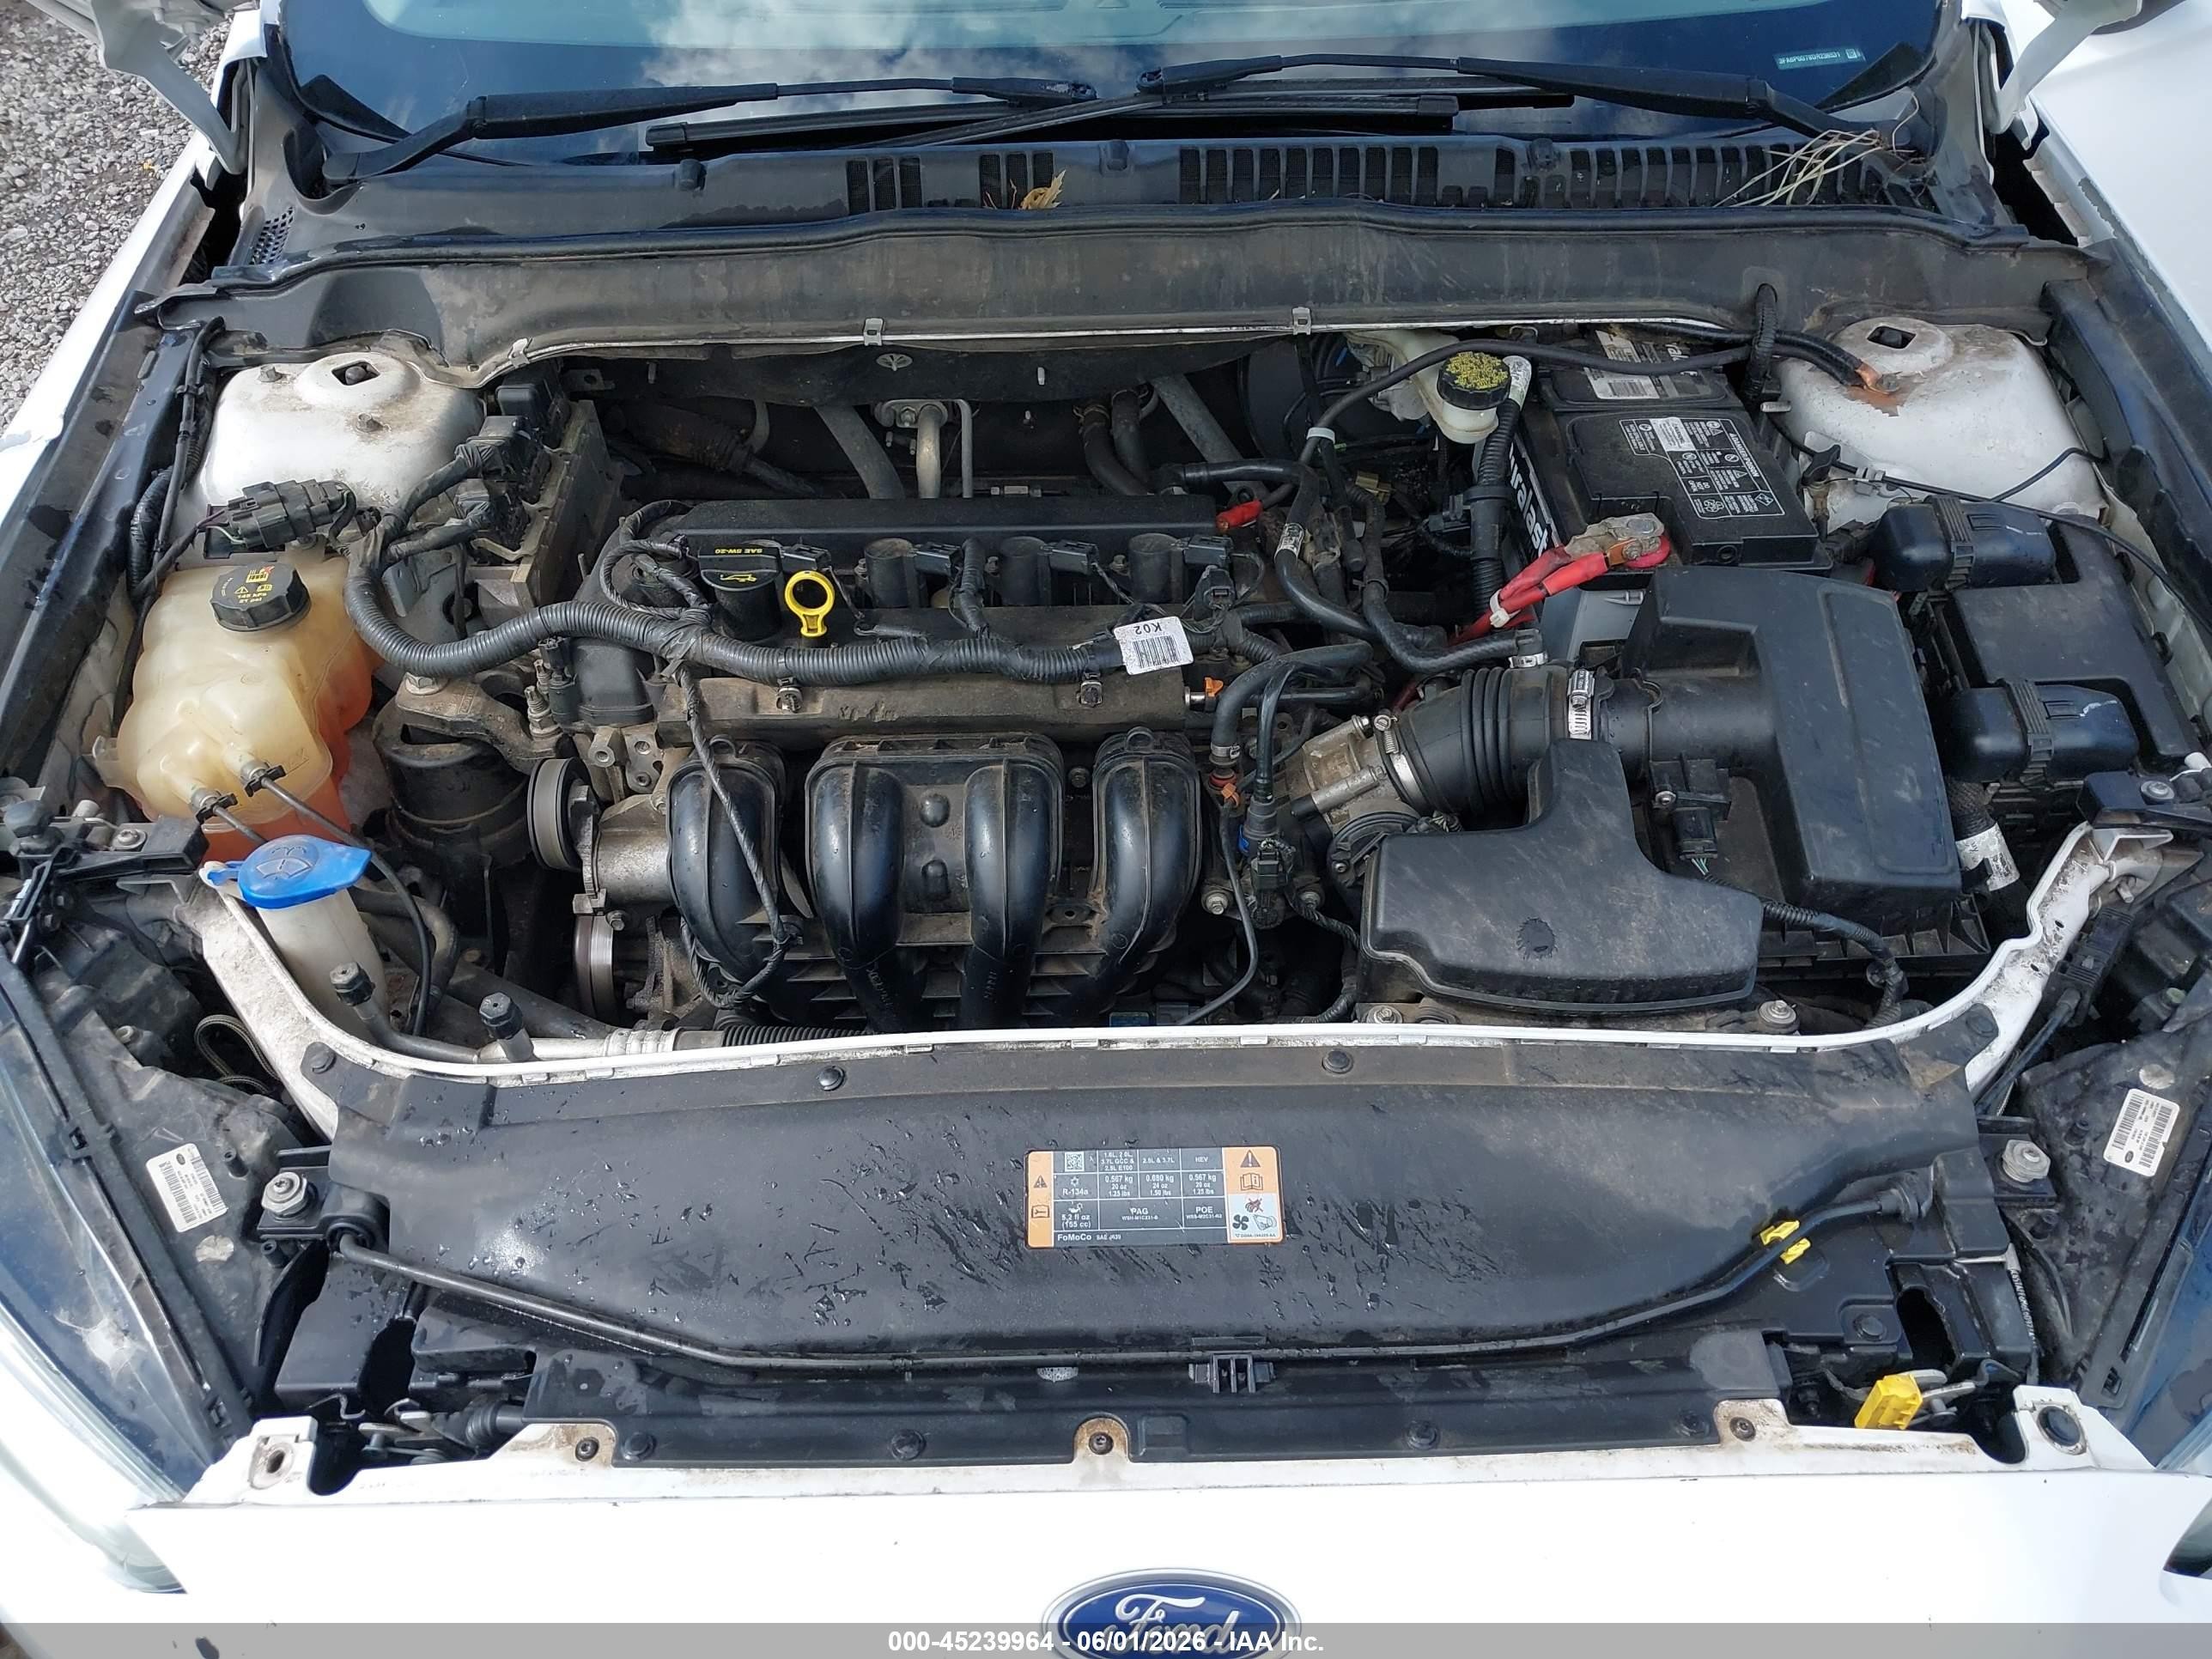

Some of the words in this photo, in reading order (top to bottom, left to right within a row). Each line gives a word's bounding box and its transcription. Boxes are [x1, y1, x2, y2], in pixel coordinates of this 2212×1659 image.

[1133, 623, 1162, 635] K02
[1124, 1175, 1133, 1183] kg
[1165, 1174, 1174, 1182] kg
[1208, 1174, 1217, 1182] kg
